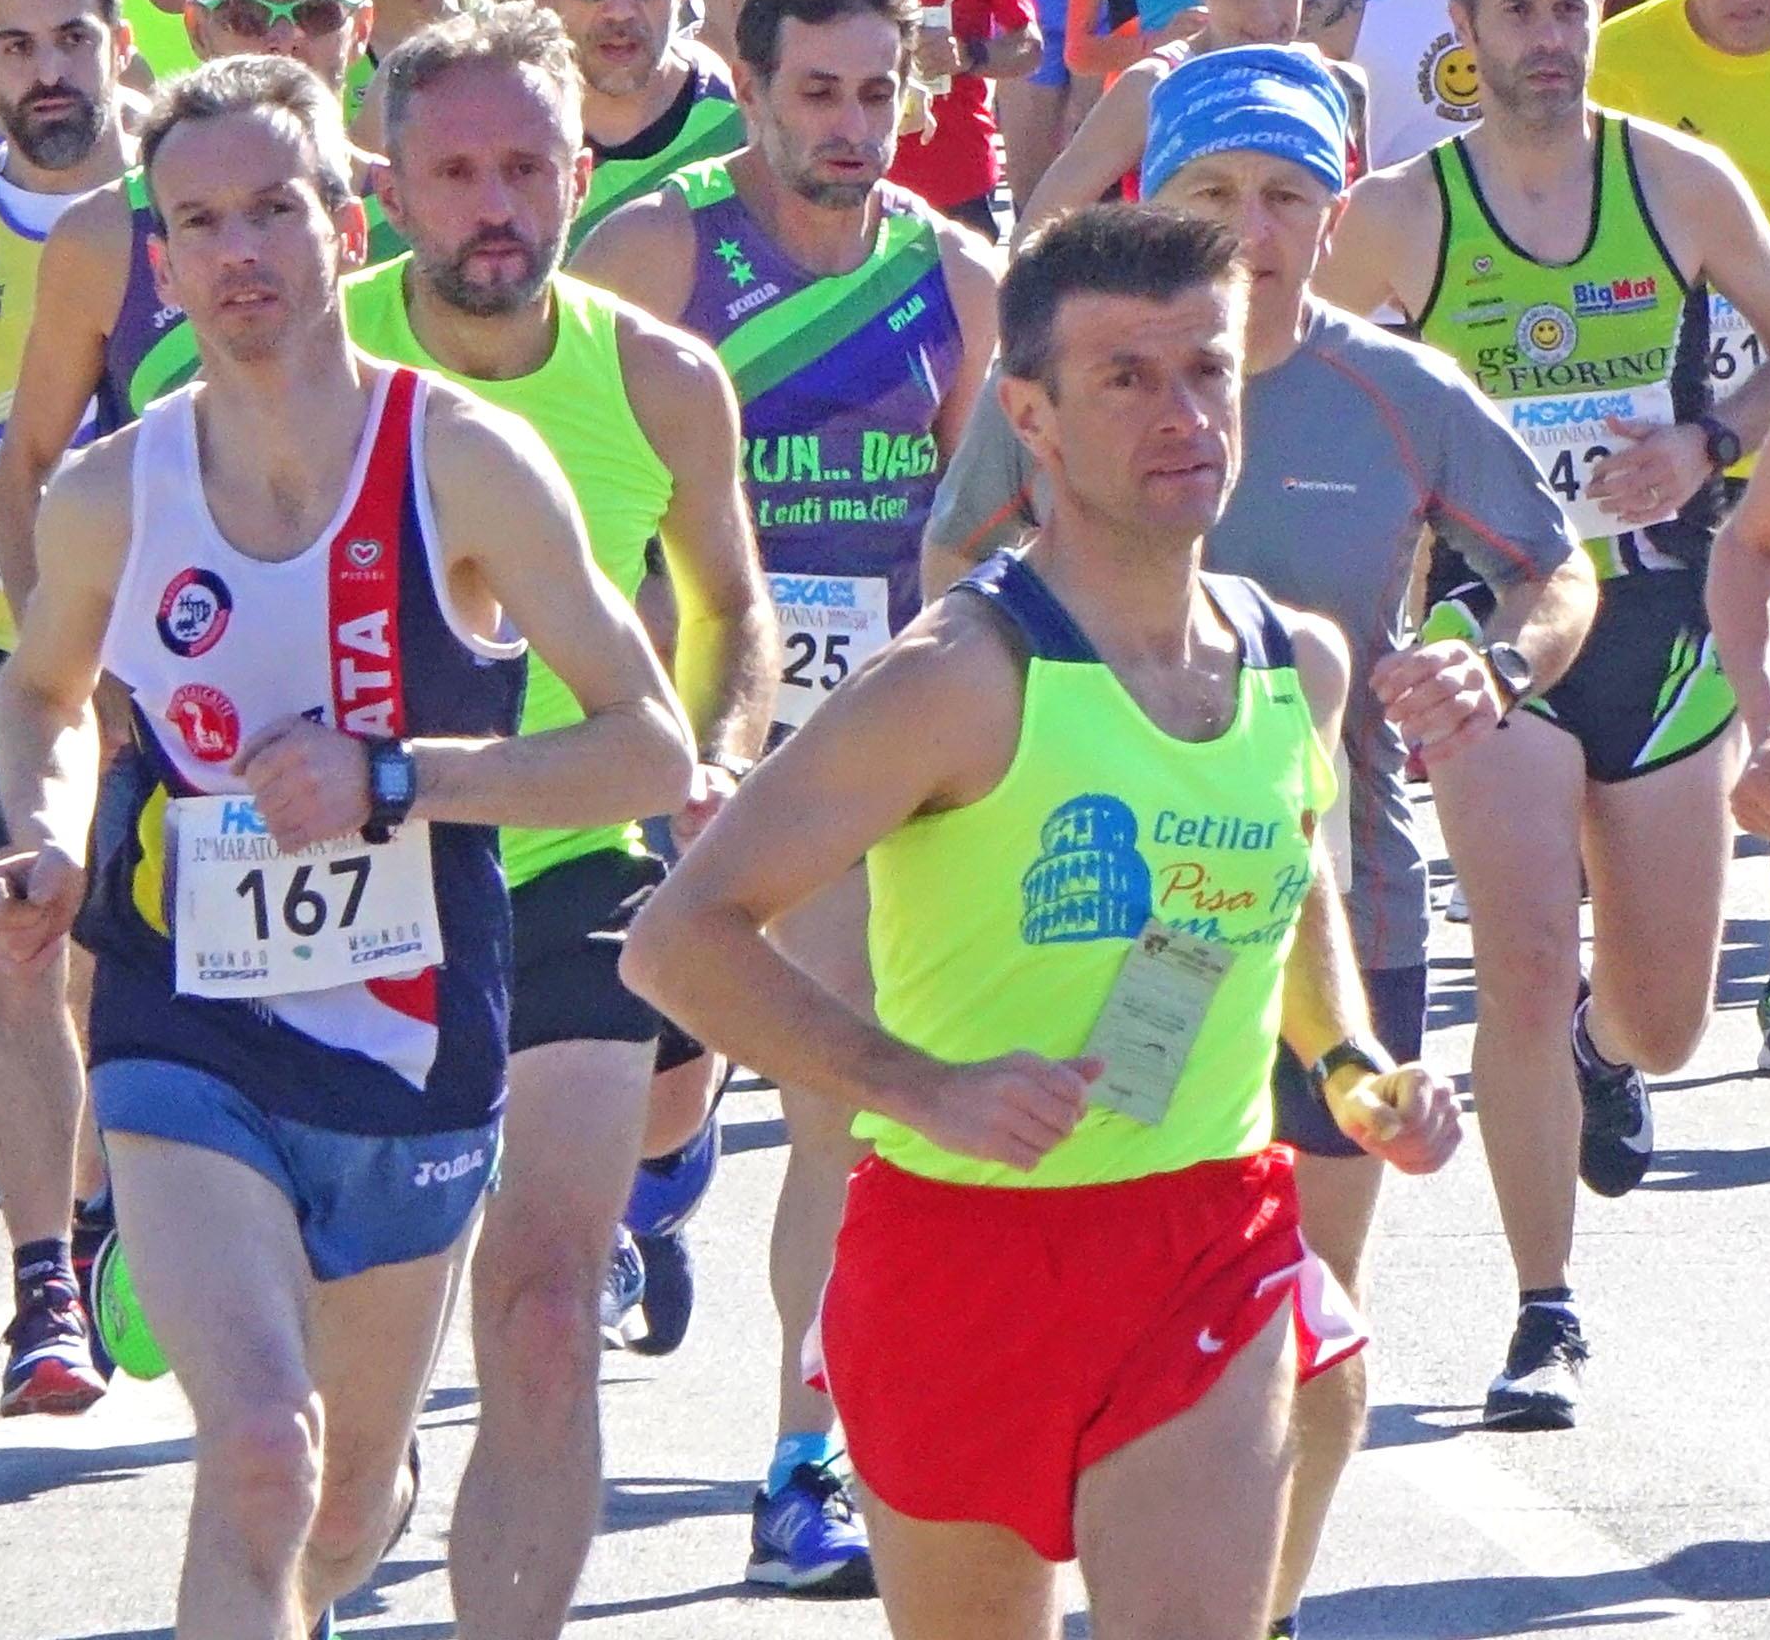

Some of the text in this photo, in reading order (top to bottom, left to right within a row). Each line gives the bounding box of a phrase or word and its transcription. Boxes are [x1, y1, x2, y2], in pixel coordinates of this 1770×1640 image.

[1573, 277, 1656, 304] BigMat
[1511, 346, 1671, 391] FIORINO
[1513, 398, 1599, 427] HOKA
[759, 496, 865, 528] Lenti ma
[769, 577, 830, 607] OKA
[338, 609, 395, 737] ATA
[1153, 810, 1283, 851] Cetilar
[236, 854, 372, 940] 167
[1159, 861, 1257, 913] Pisa
[351, 941, 423, 965] CORSA
[197, 967, 268, 981] CORSA
